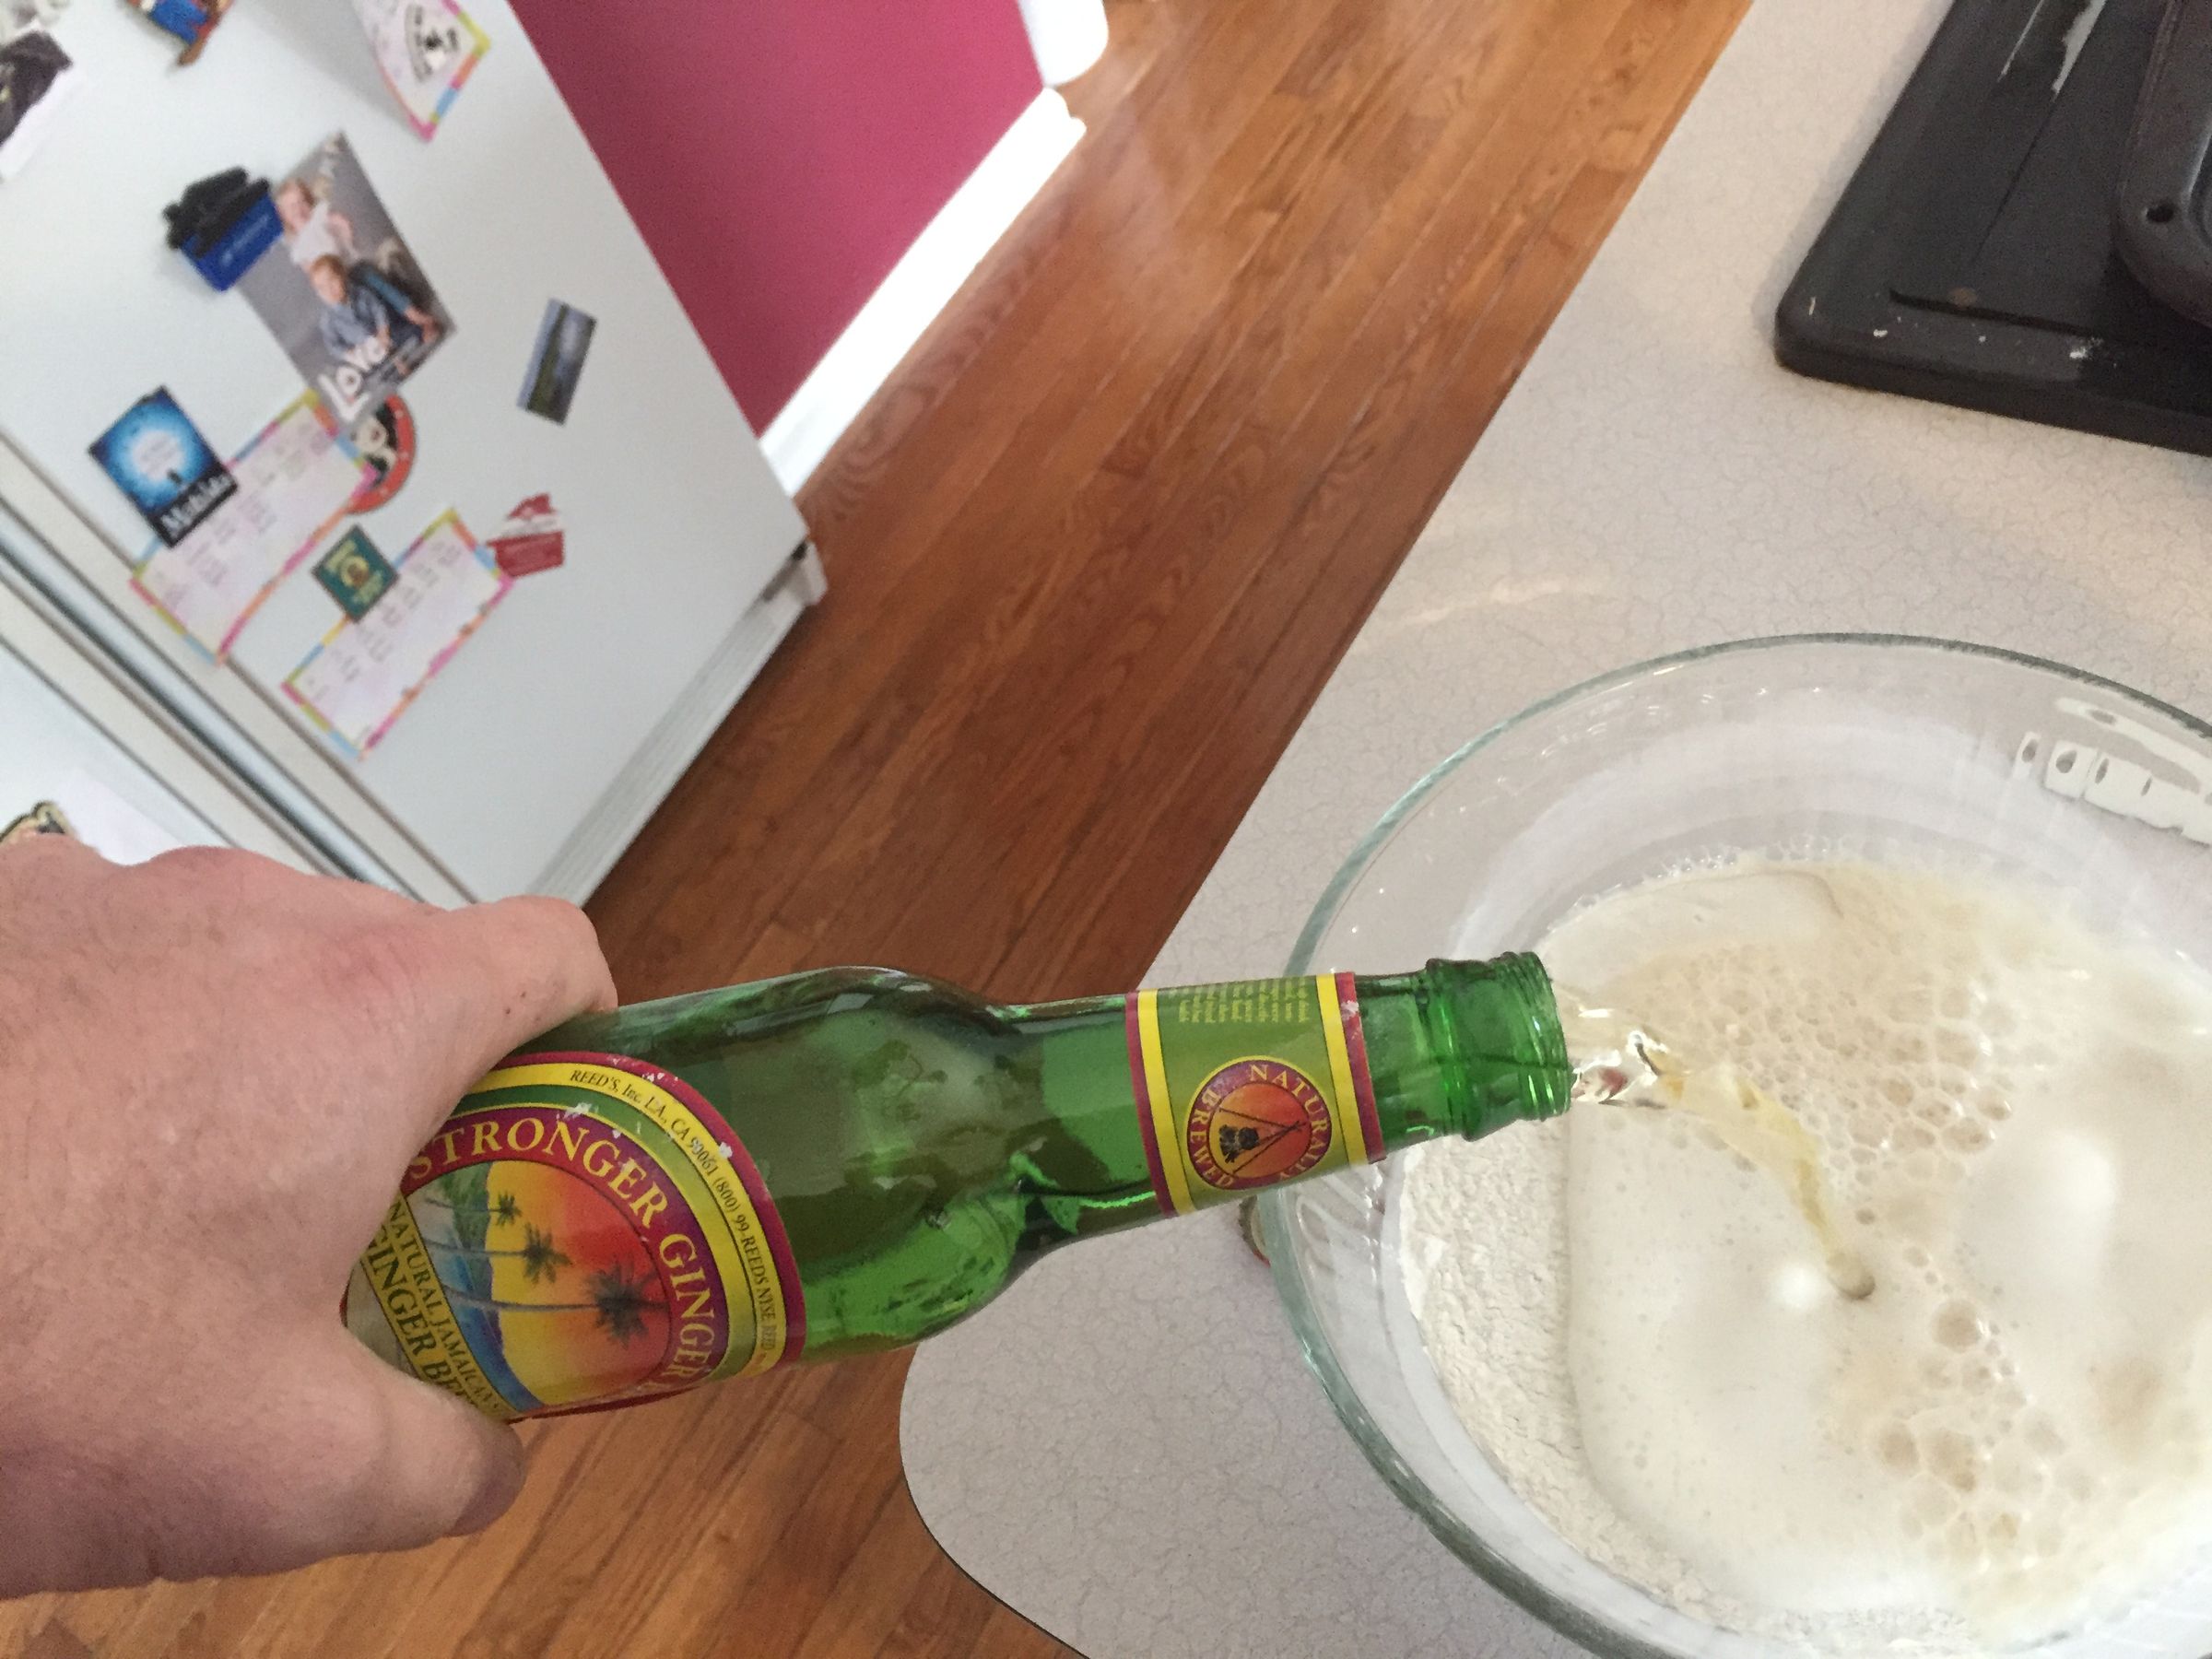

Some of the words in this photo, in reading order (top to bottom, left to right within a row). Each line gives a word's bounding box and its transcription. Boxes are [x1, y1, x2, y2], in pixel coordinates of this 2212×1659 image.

[671, 1118, 691, 1141] CA
[712, 1176, 741, 1214] (800)
[1190, 1088, 1236, 1189] BREWED
[388, 1200, 444, 1316] NATURAL
[409, 1116, 669, 1230] STRONGER
[658, 1232, 717, 1381] GINGER
